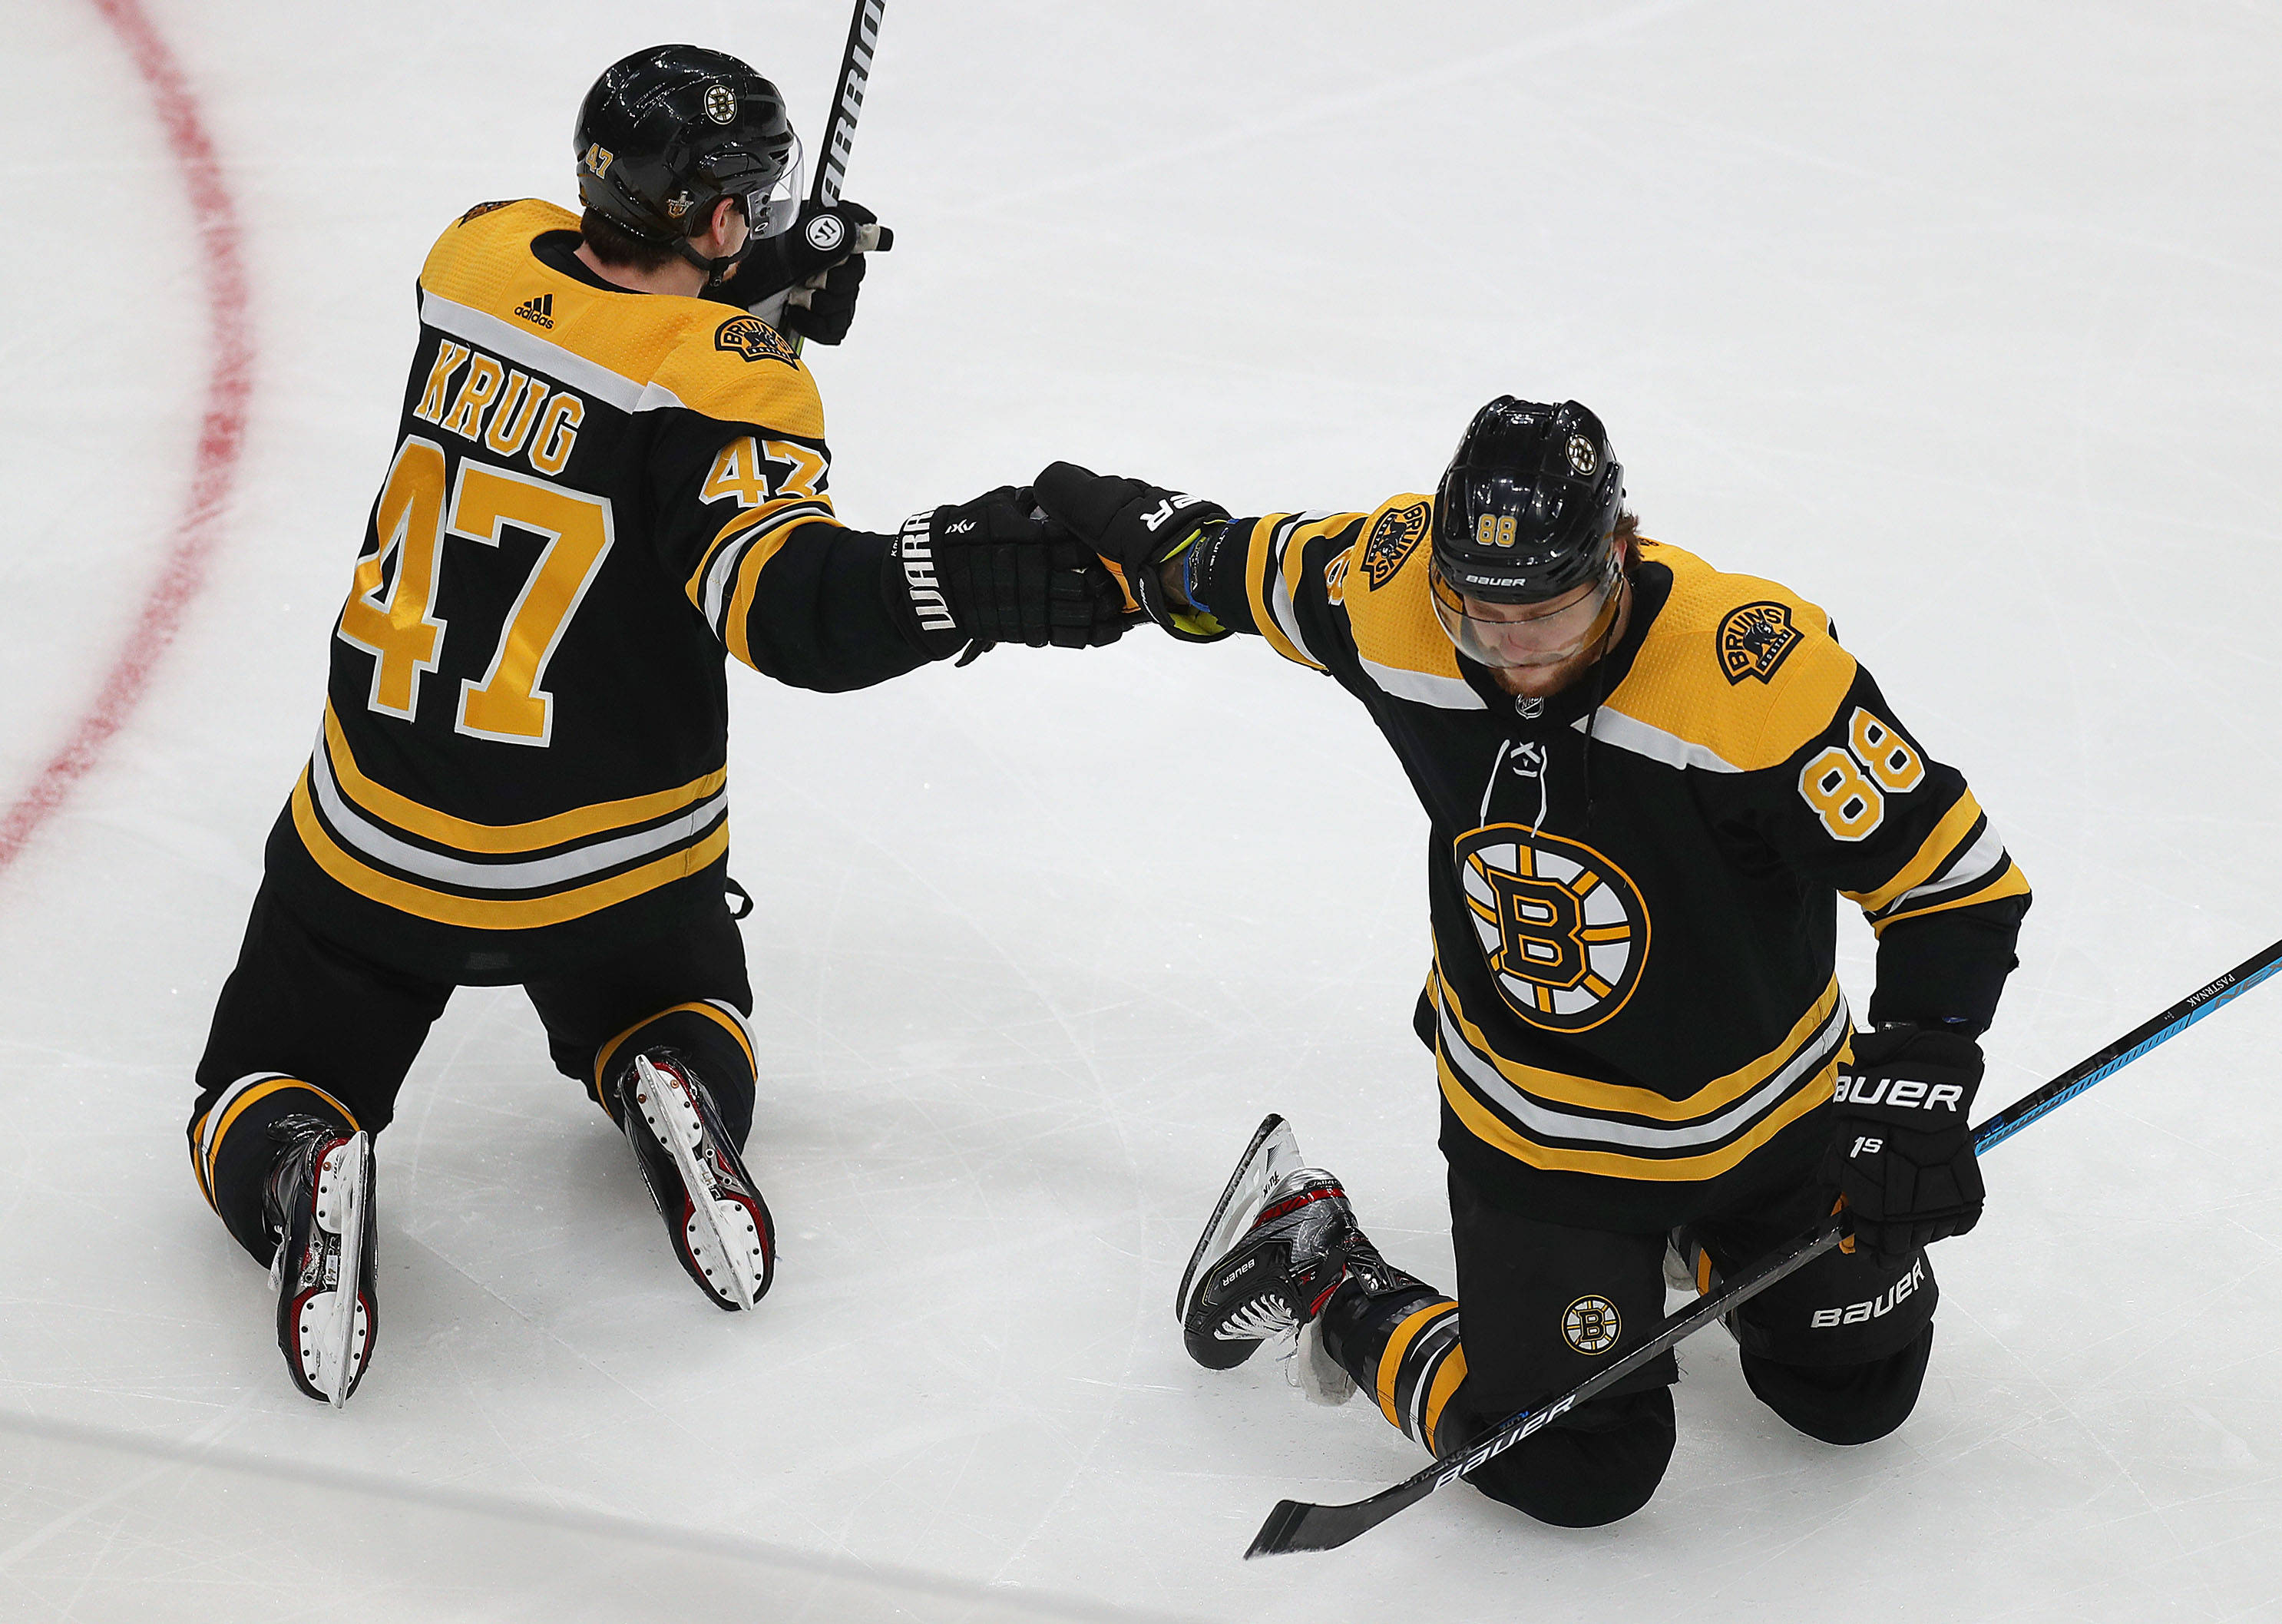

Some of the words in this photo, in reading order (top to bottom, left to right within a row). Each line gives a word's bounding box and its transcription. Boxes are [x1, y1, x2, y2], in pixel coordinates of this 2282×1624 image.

[822, 0, 882, 207] ARRIO
[586, 143, 613, 179] 47
[514, 306, 554, 329] adidas
[723, 320, 792, 352] BRUINS
[413, 339, 584, 476] KRUG
[699, 437, 828, 508] 47
[1375, 506, 1423, 579] BRUINS
[1477, 513, 1518, 548] 88
[337, 434, 614, 748] 47
[1725, 608, 1782, 672] BRUINS
[1797, 706, 1926, 842] 88
[1486, 867, 1587, 987] B
[2186, 974, 2236, 1007] PASTRNAK
[1834, 1075, 1963, 1112] AUER
